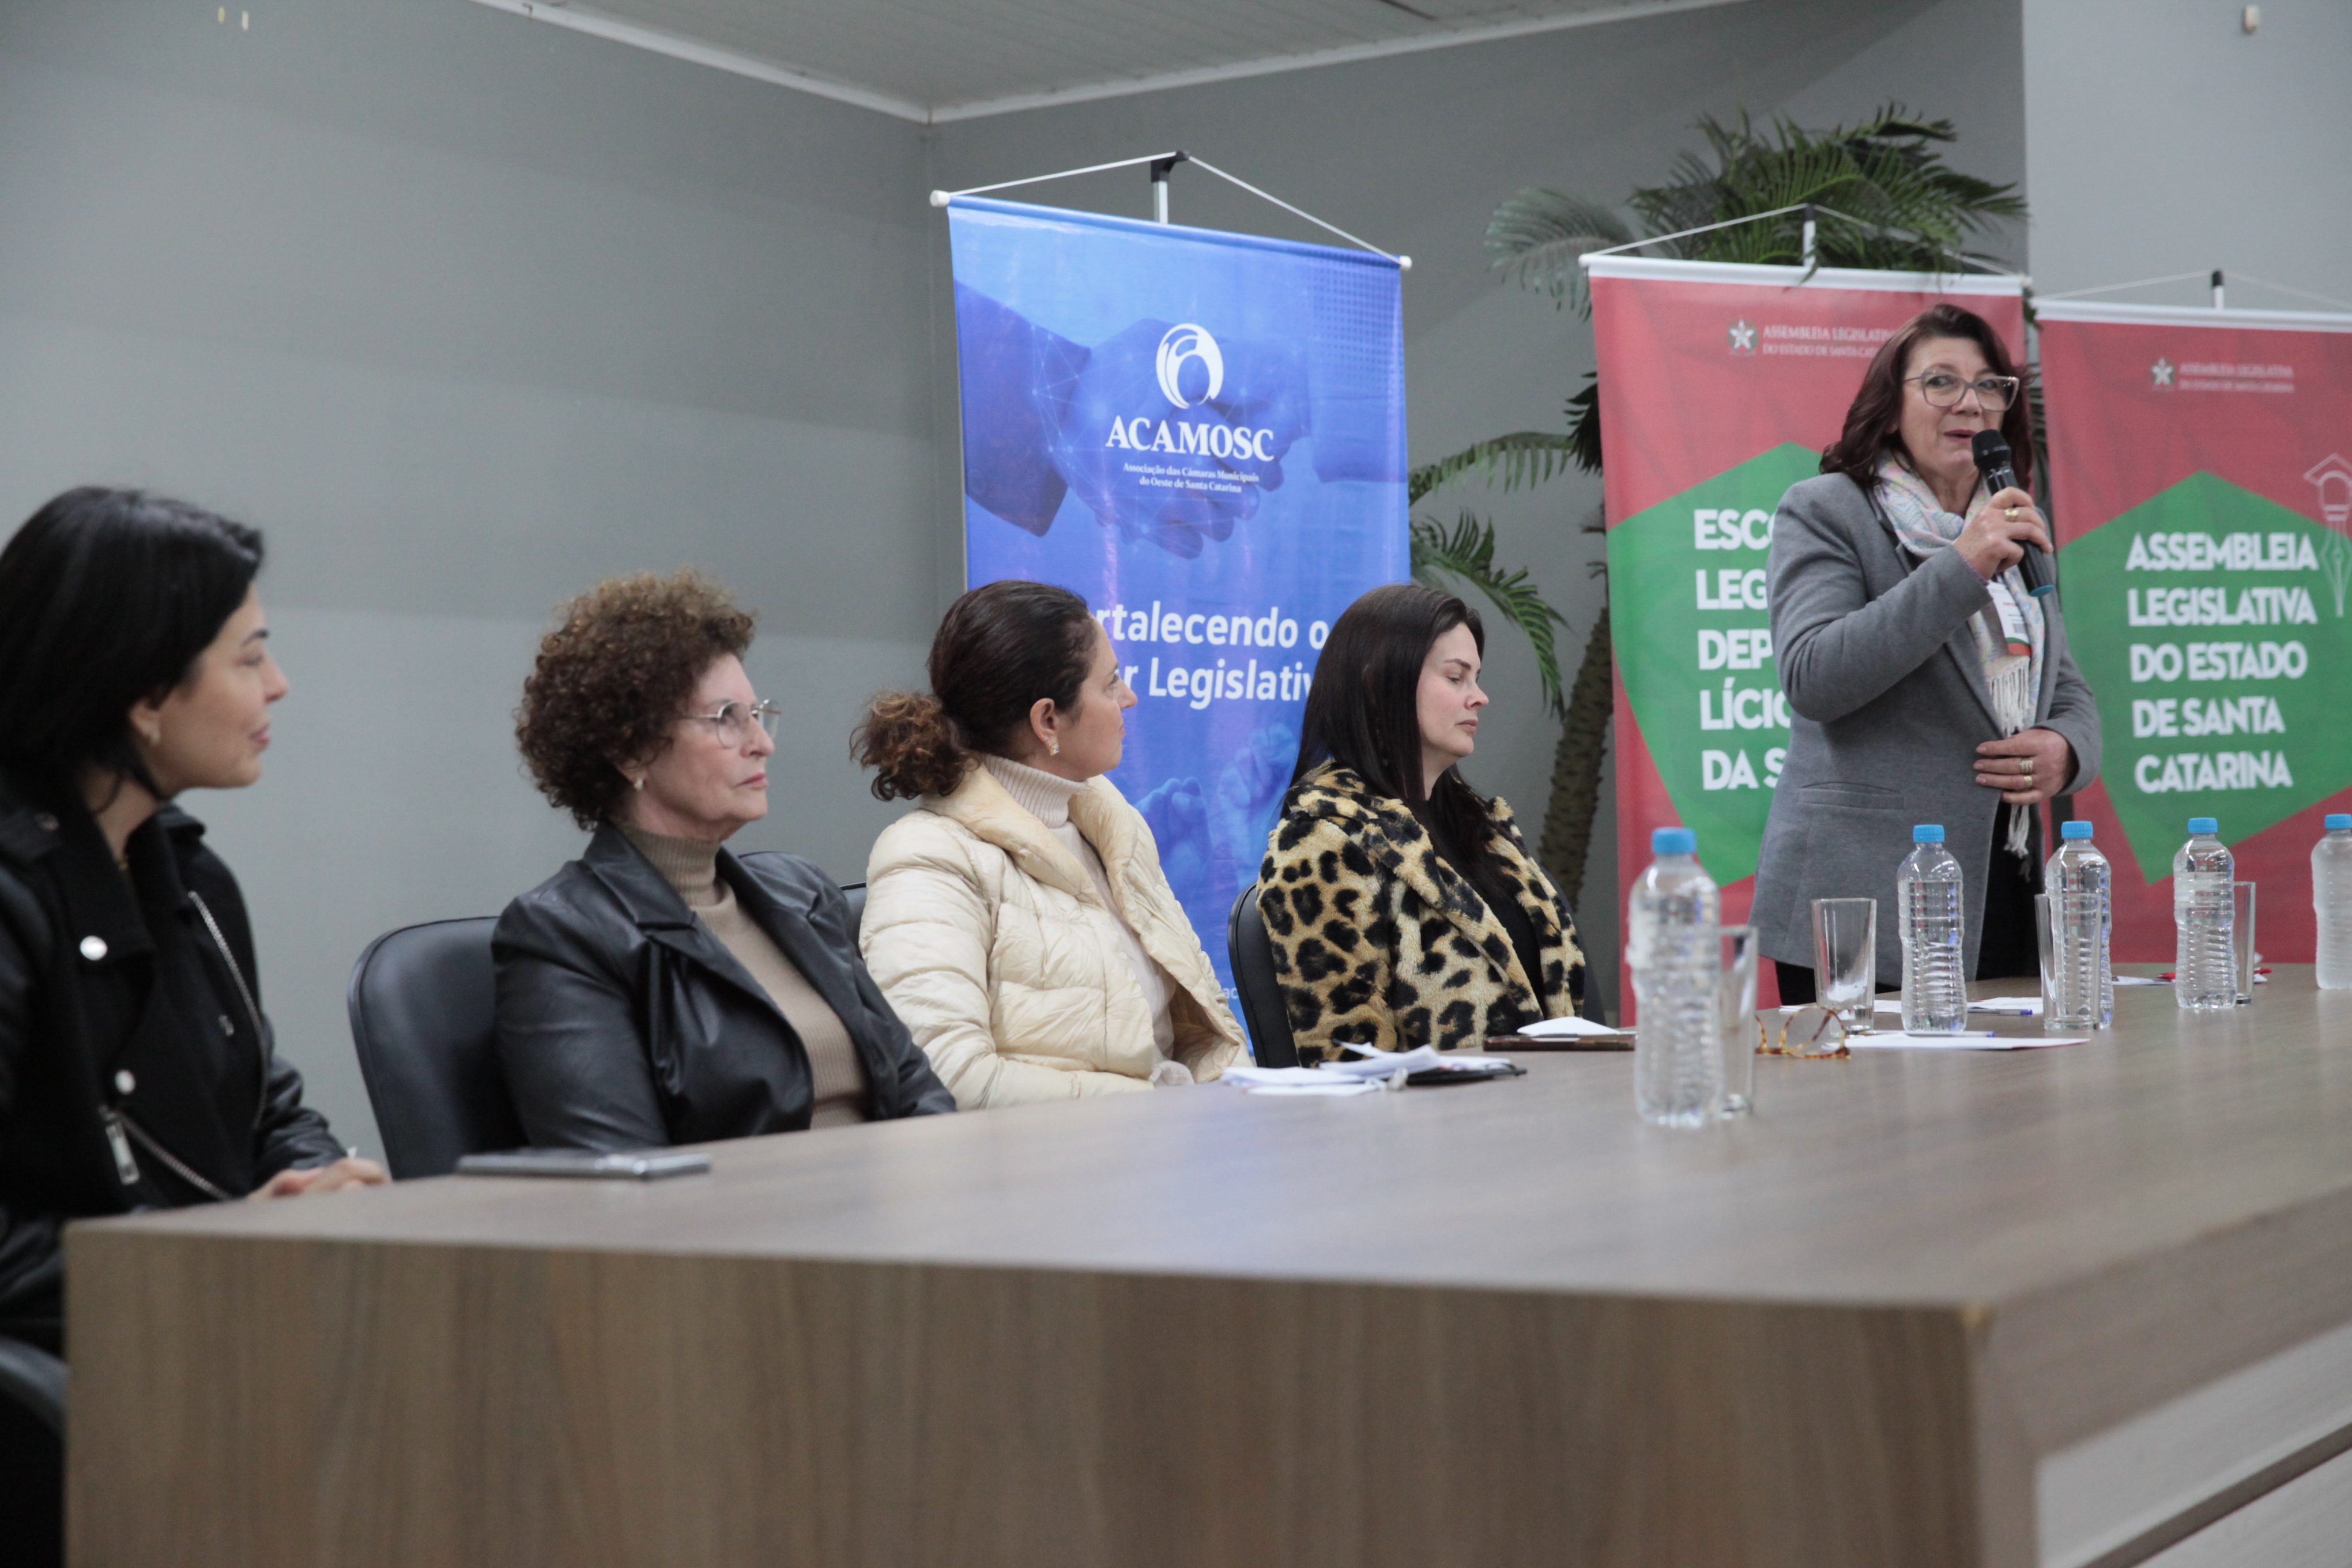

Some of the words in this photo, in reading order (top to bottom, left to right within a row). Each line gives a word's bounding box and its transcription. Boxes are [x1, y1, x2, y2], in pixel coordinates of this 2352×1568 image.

[1105, 415, 1275, 462] ACAMOSC
[1123, 462, 1165, 476] Associação
[1166, 465, 1181, 476] das
[1182, 466, 1216, 478] Câmaras
[1217, 469, 1260, 484] Municipais
[1139, 476, 1150, 486] do
[1151, 477, 1174, 488] Oeste
[1174, 478, 1184, 488] de
[1185, 479, 1208, 490] Santa
[1209, 481, 1242, 493] Catarina
[1694, 509, 1774, 550] ESC
[2125, 532, 2319, 571] ASSEMBLEIA
[1097, 601, 1298, 648] rtalecendo
[2127, 587, 2318, 627] LEGISLATIVA
[2129, 643, 2184, 682] DO
[2187, 640, 2308, 681] ESTADO
[1149, 657, 1311, 710] Legislati
[2132, 698, 2179, 738] DE
[2182, 696, 2286, 736] SANTA
[1702, 749, 1759, 790] DA
[2134, 751, 2294, 794] CATARINA
